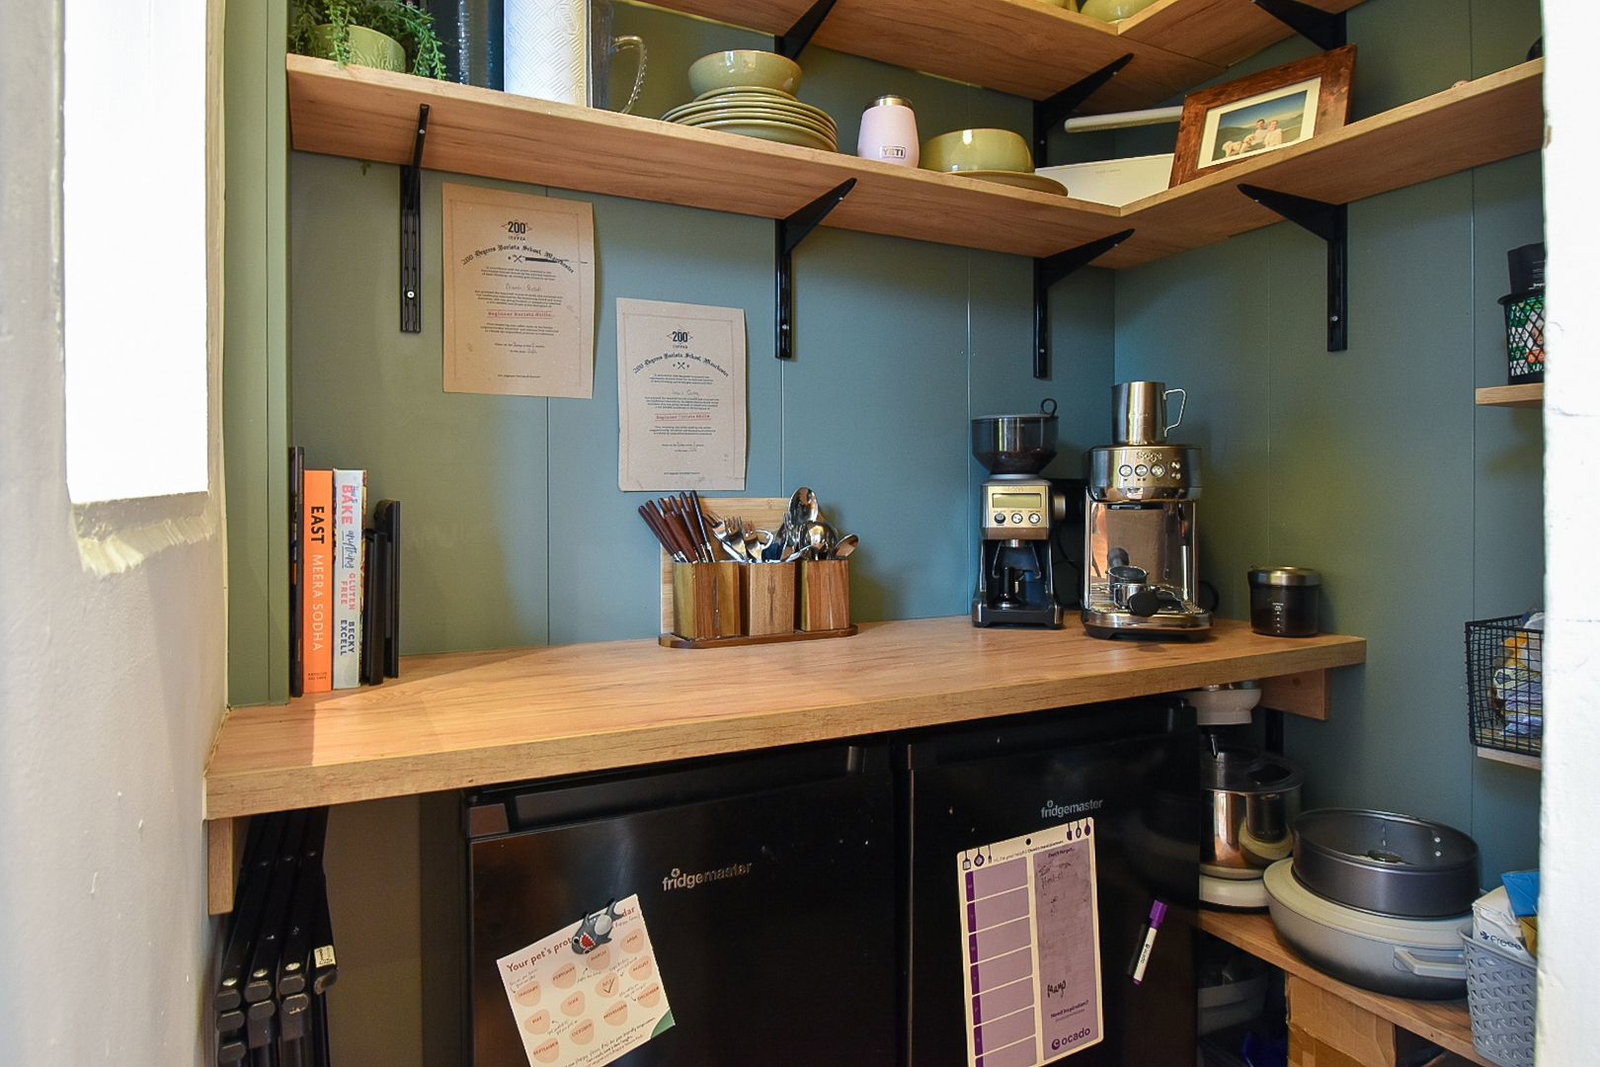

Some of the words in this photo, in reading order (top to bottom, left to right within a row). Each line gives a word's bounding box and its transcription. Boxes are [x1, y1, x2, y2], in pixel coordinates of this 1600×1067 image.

[882, 148, 904, 157] YETI
[342, 484, 355, 525] BAKE
[310, 506, 325, 545] EAST
[312, 554, 325, 599] MEERA
[340, 580, 348, 605] FREE
[348, 572, 356, 610] GLUTEN
[312, 603, 324, 651] SODHA
[340, 619, 348, 656] EXCELL
[347, 621, 355, 653] BECKY
[1041, 799, 1103, 819] fridgemaster
[662, 861, 752, 891] fridgemaster
[506, 959, 528, 972] Your
[530, 947, 552, 966] pet's
[553, 936, 573, 954] prot
[1061, 1027, 1091, 1046] ocado
